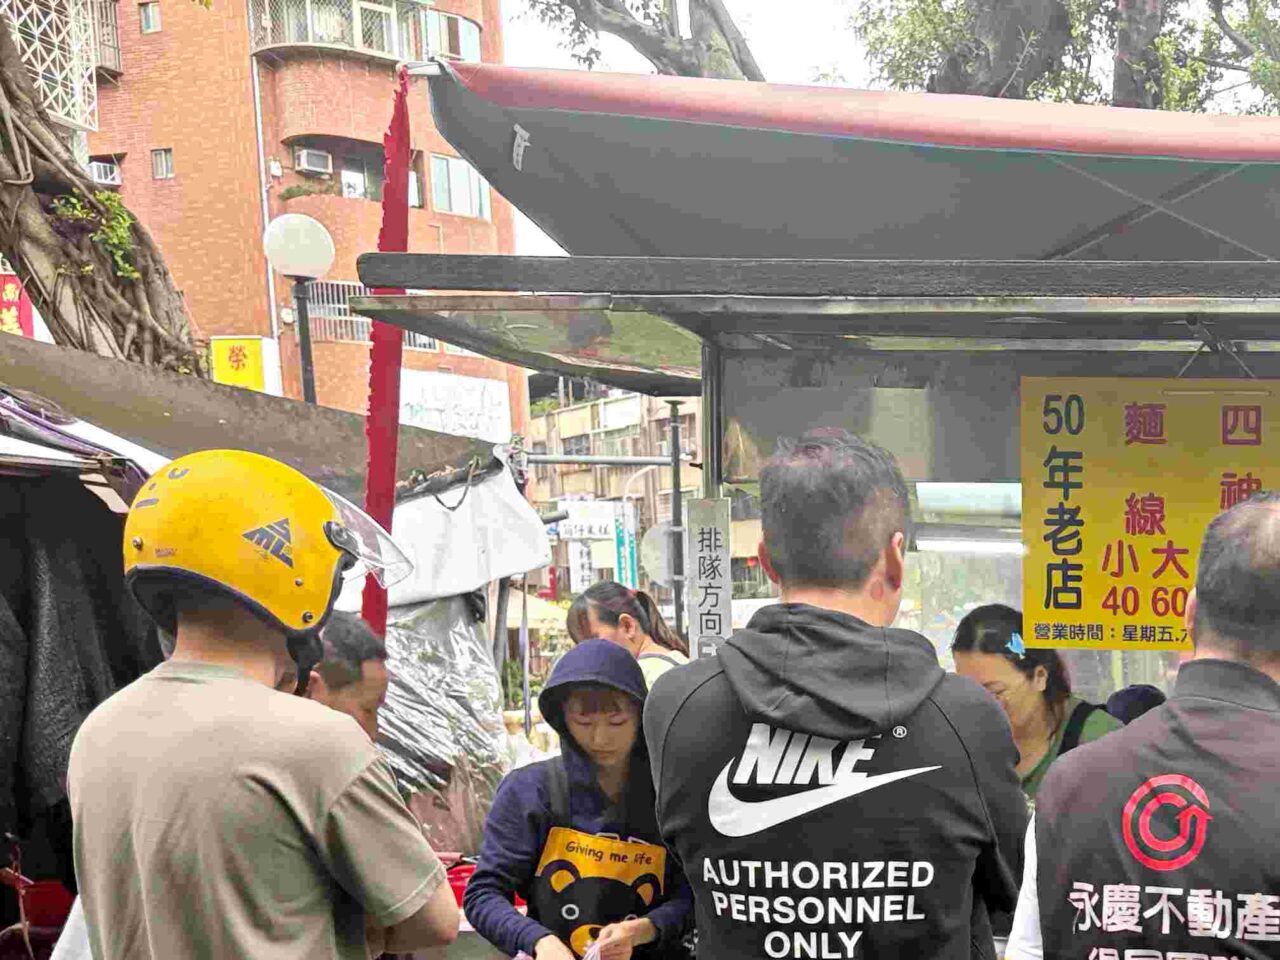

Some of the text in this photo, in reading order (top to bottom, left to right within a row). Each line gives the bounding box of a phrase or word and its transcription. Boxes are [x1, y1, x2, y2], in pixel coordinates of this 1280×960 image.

[1042, 394, 1086, 611] 50年老店
[1102, 539, 1189, 579] 小 大
[697, 527, 723, 636] 排隊方向
[1102, 585, 1188, 617] 40 60
[732, 723, 882, 785] NIKE
[565, 841, 652, 865] Giving me life
[702, 857, 935, 889] AUTHORIZED
[711, 890, 926, 925] PERSONNEL
[763, 930, 864, 960] ONLY
